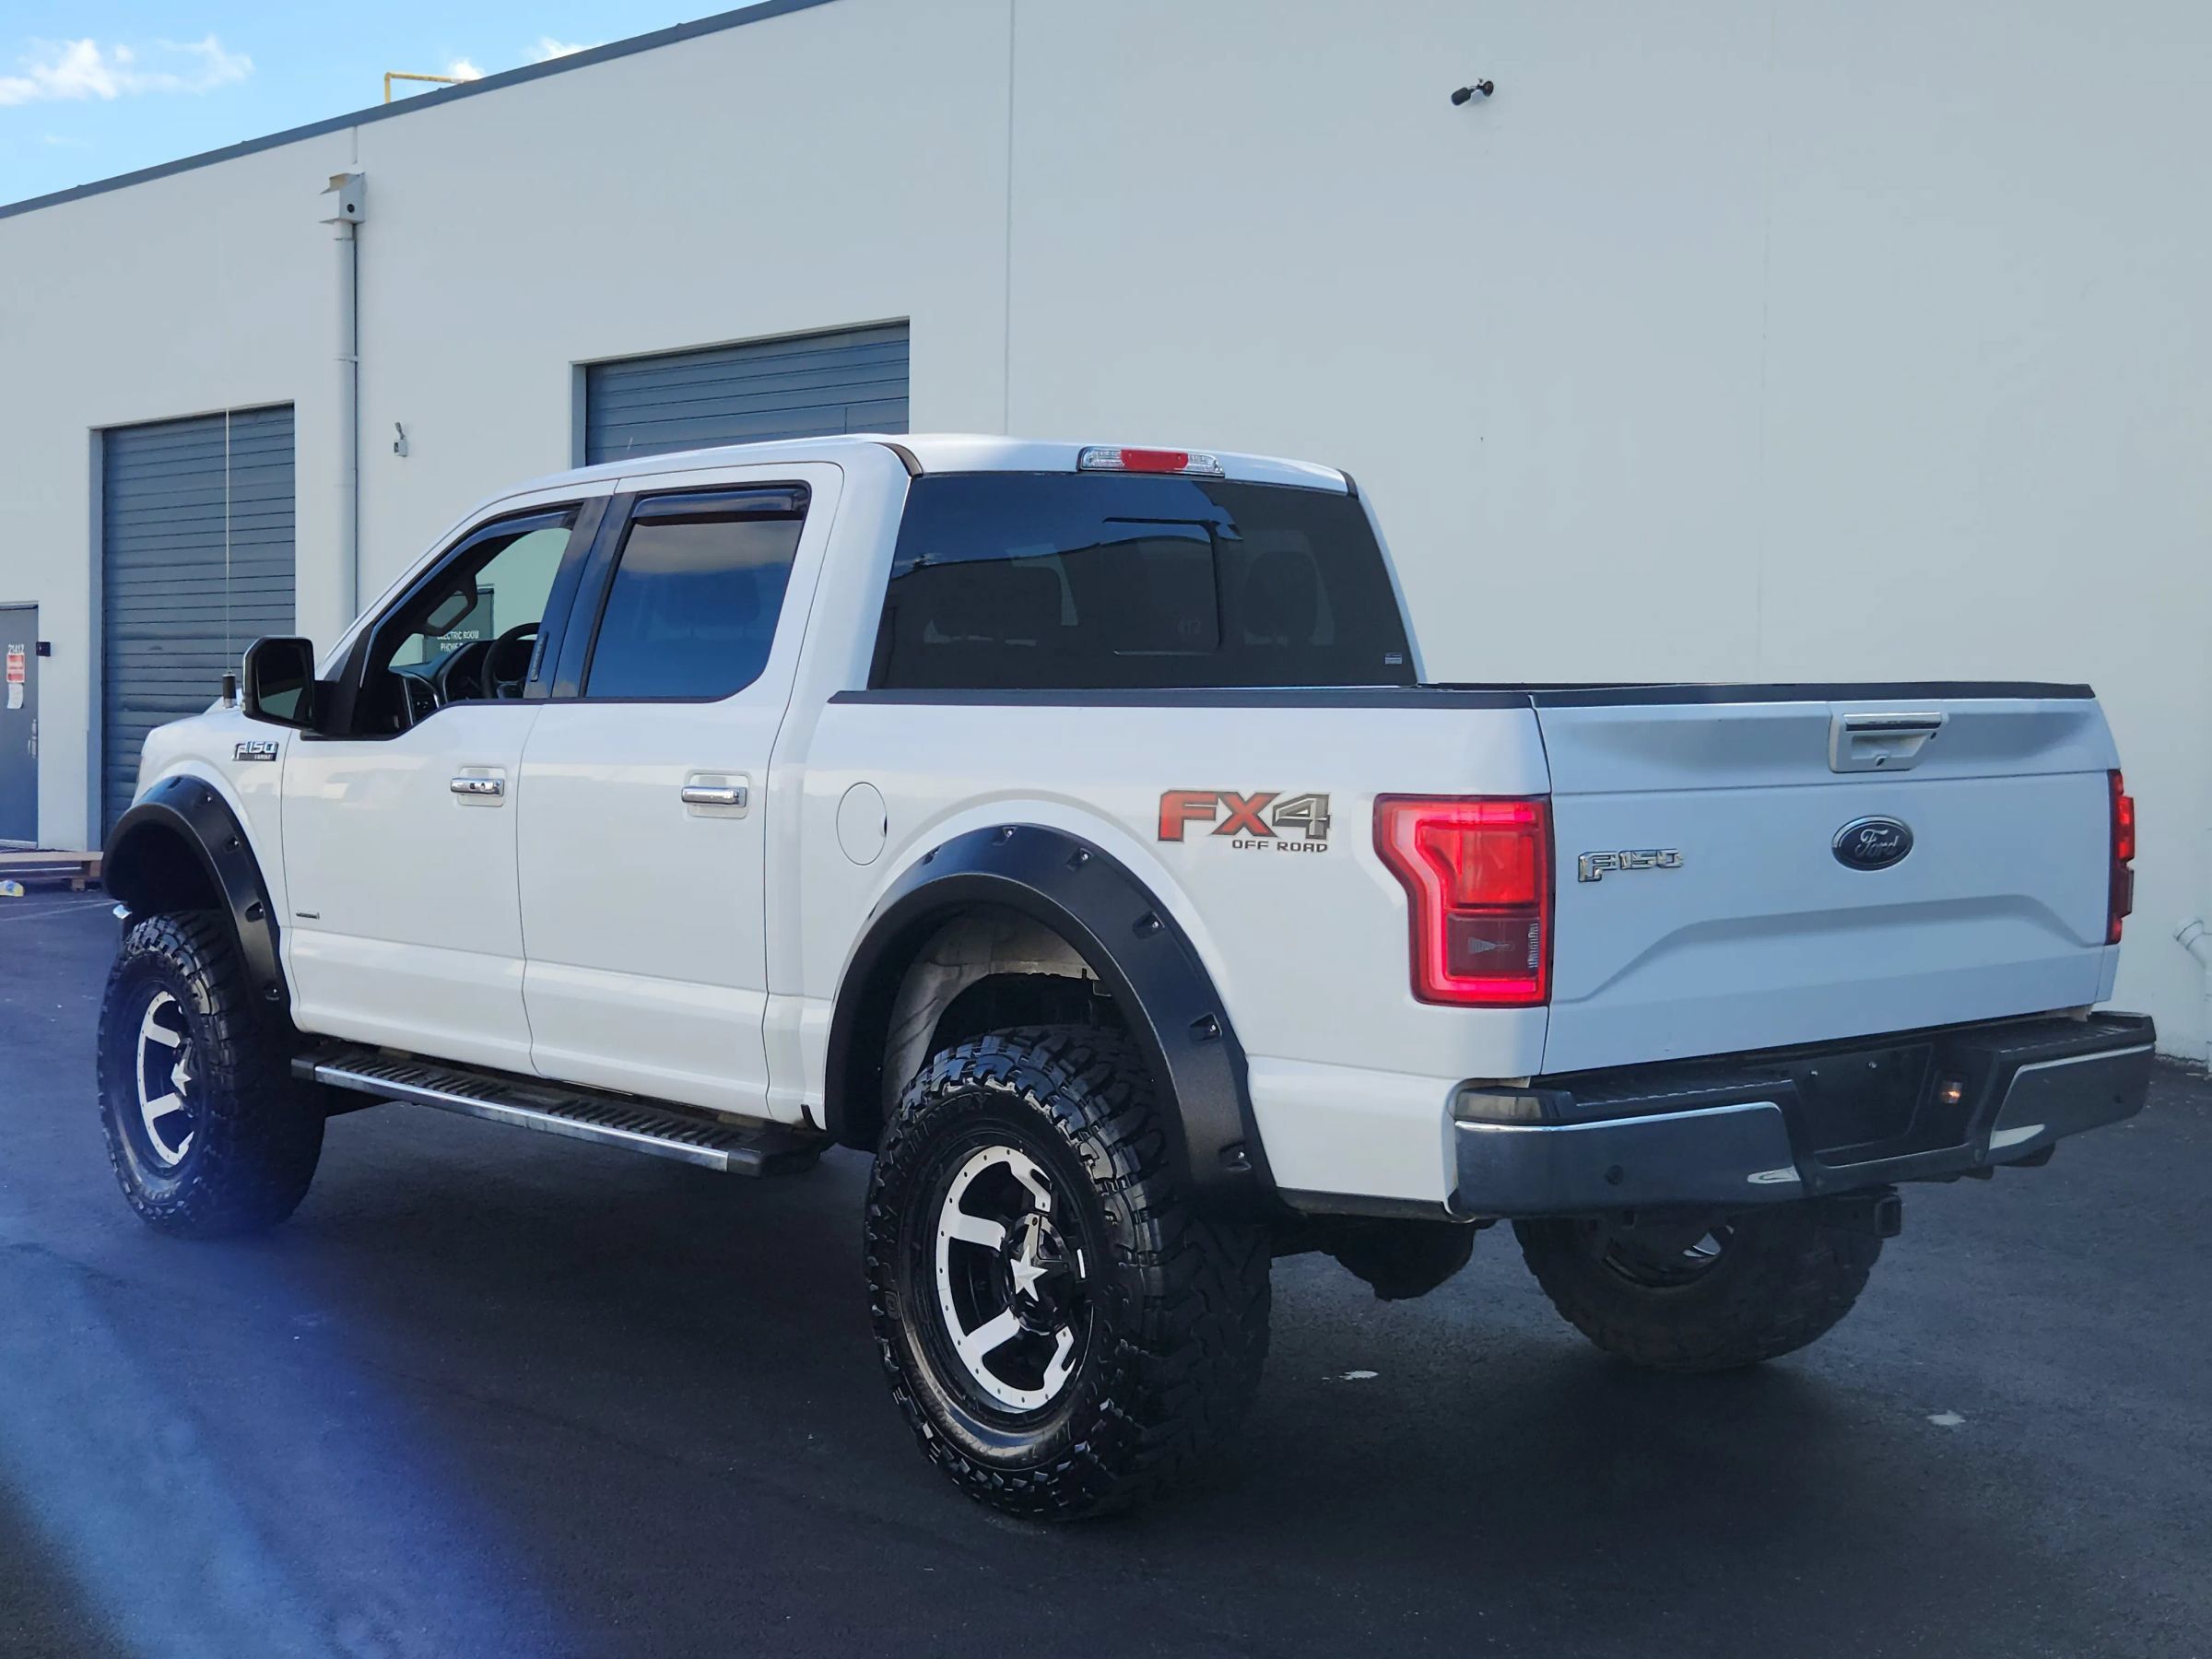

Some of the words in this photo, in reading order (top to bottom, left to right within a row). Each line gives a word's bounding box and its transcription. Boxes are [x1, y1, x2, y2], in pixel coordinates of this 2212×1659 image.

[463, 629, 479, 639] ROOM
[1158, 790, 1330, 842] FX4
[1232, 840, 1268, 850] OFF
[1277, 842, 1328, 853] ROAD
[1854, 829, 1900, 858] Ford
